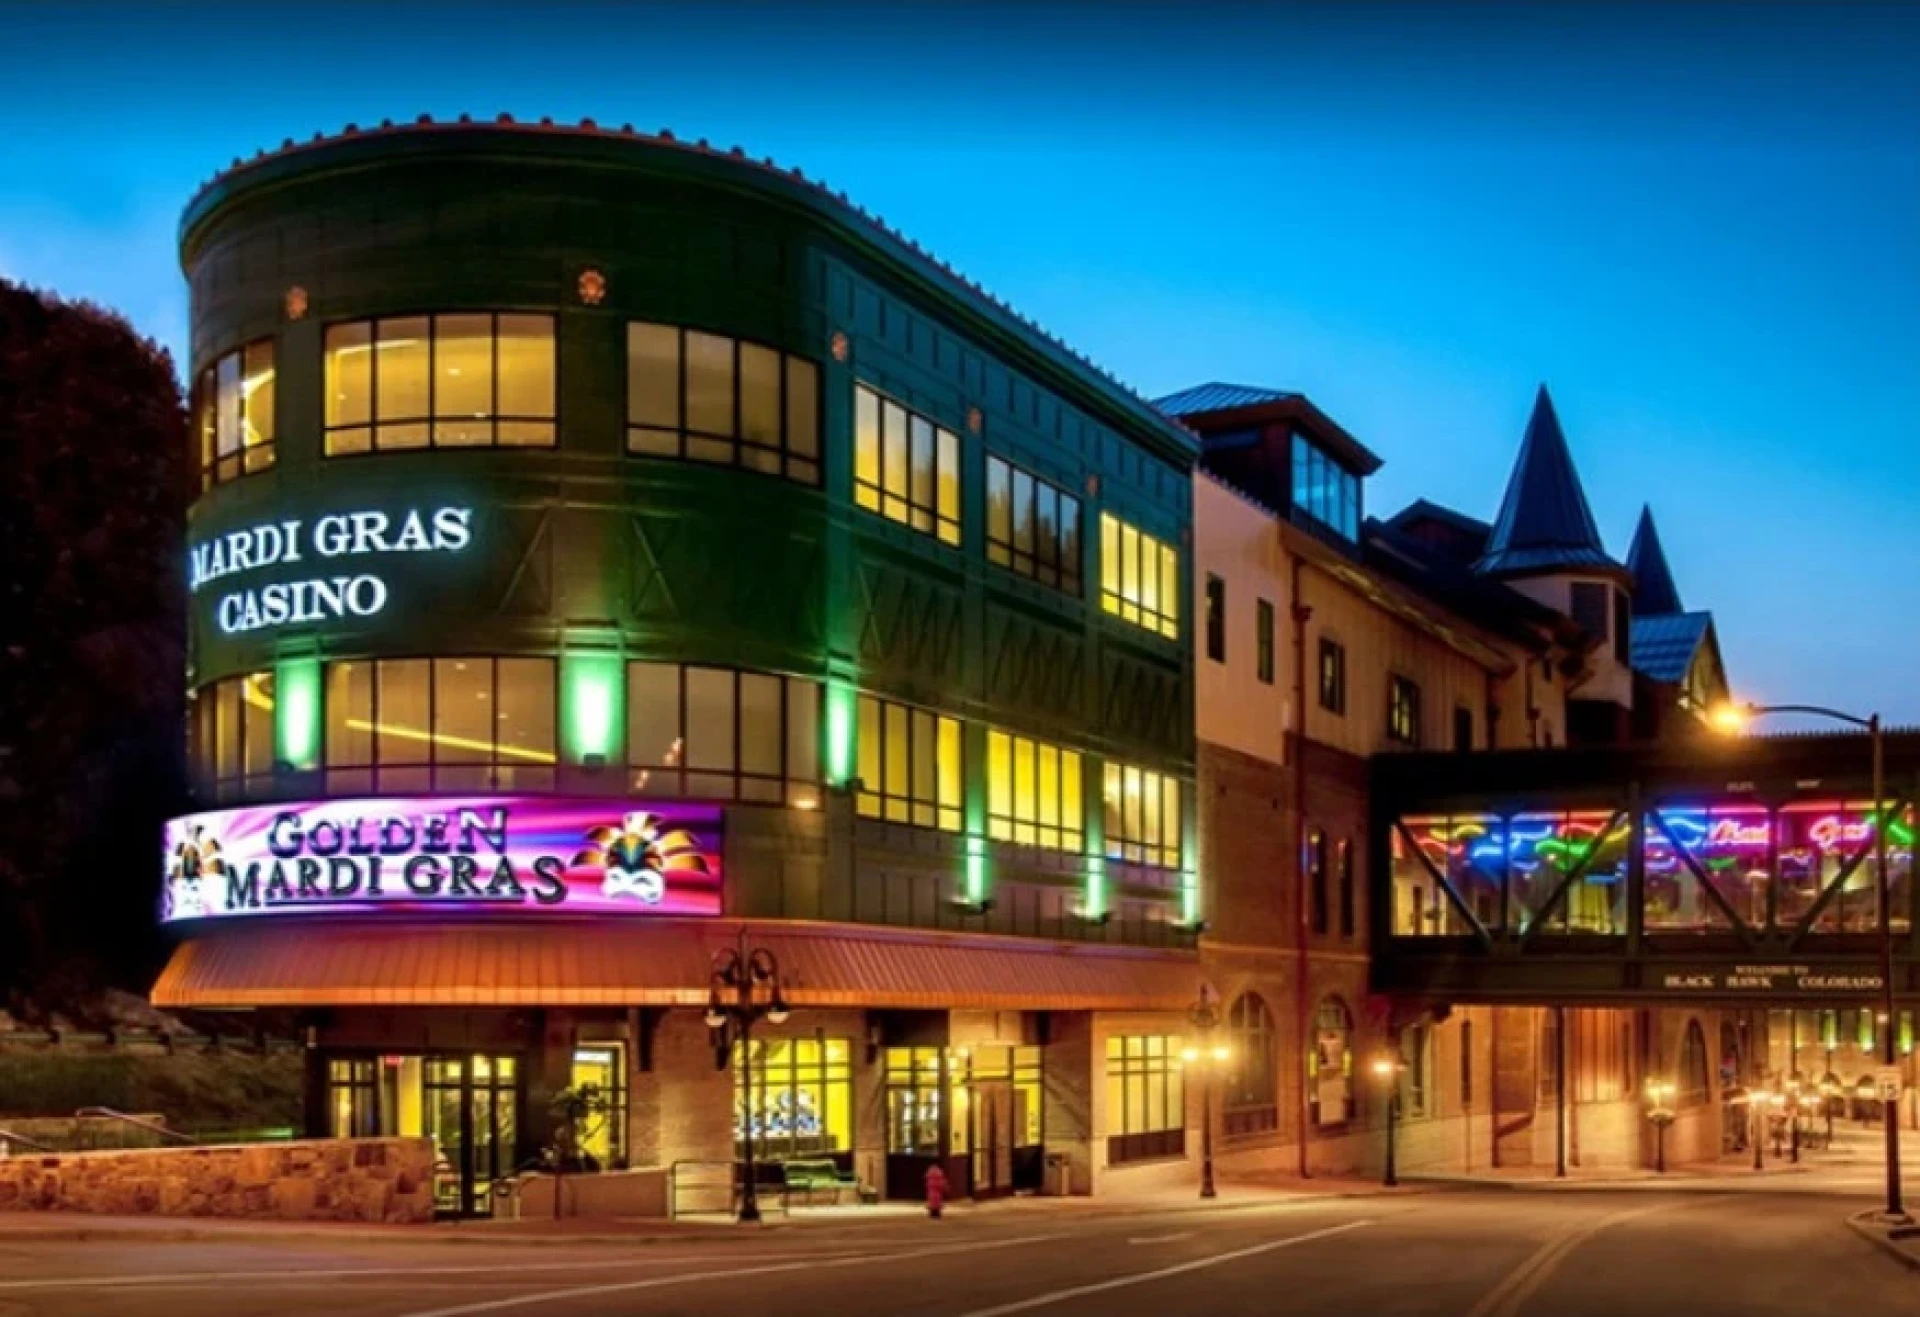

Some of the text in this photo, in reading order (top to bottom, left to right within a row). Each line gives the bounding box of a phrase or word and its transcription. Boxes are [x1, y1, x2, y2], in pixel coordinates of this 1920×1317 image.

[313, 507, 473, 557] GRAS
[218, 574, 388, 633] CASINO
[267, 806, 507, 859] GOLDEN
[226, 855, 567, 909] MARDI GRAS
[1664, 975, 1884, 988] BLACK HAWK COLORADO
